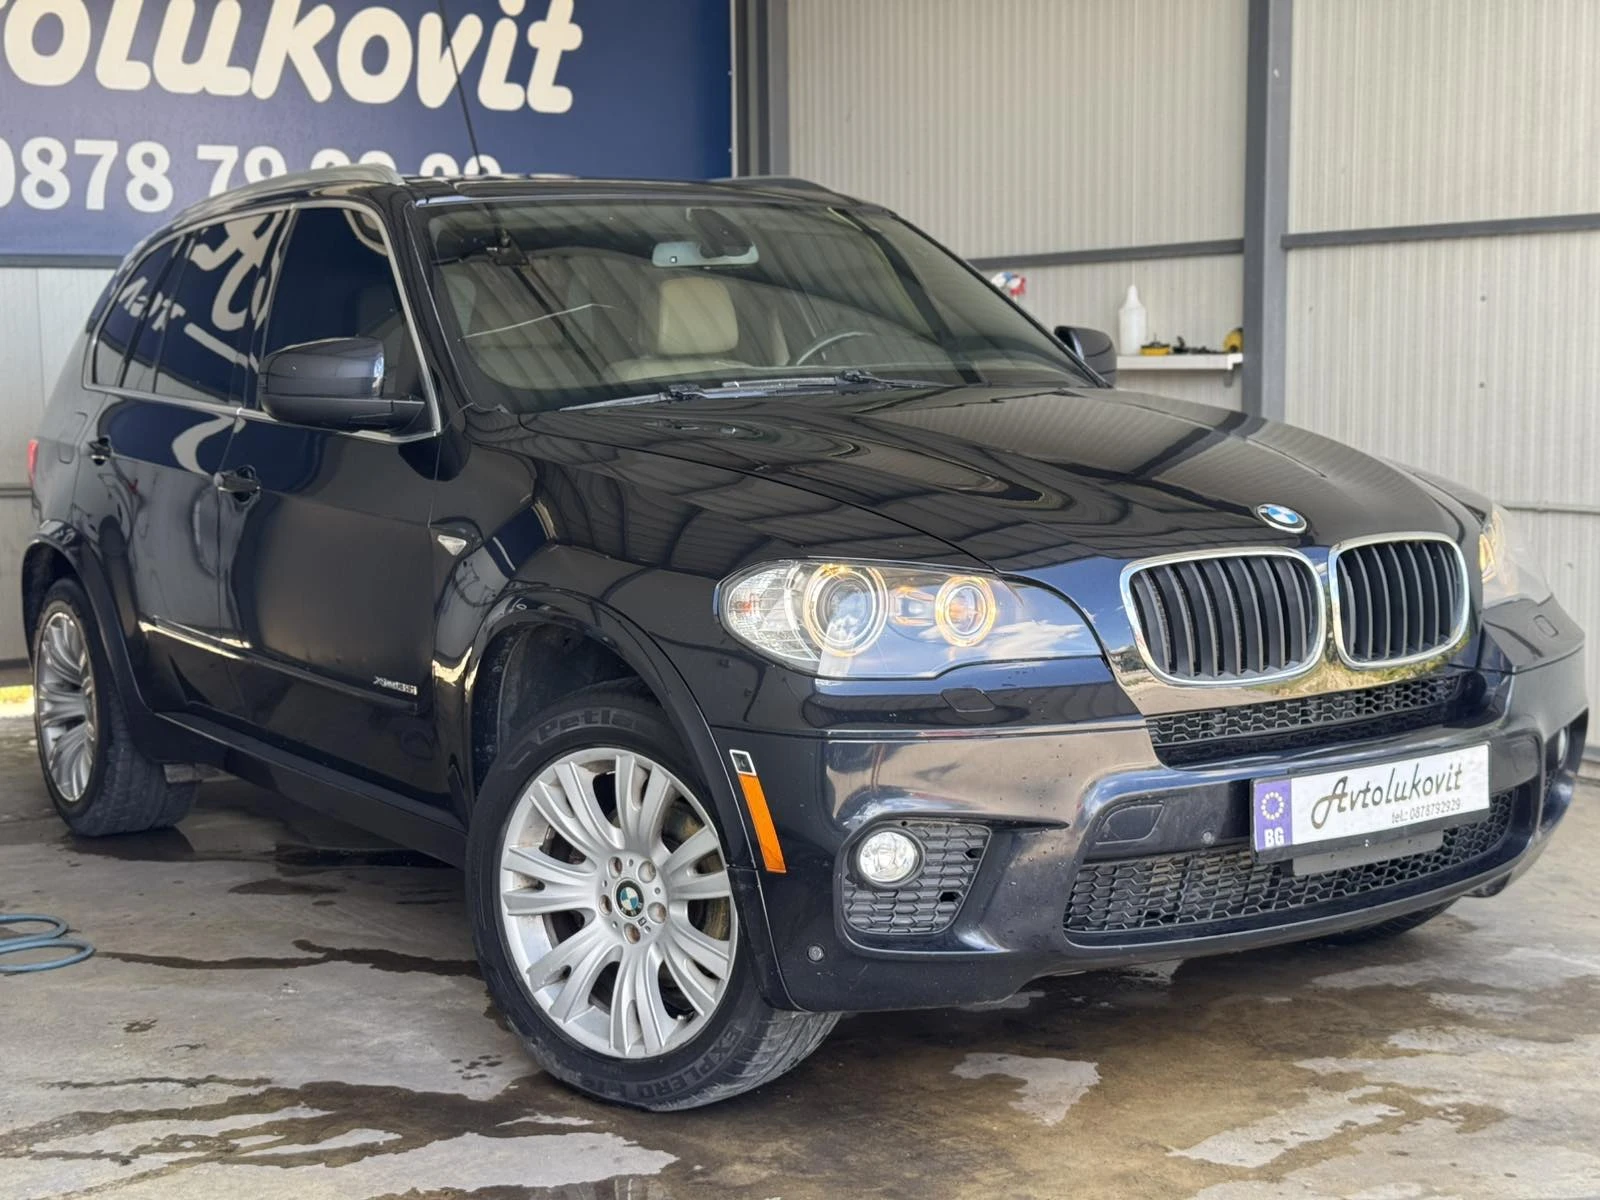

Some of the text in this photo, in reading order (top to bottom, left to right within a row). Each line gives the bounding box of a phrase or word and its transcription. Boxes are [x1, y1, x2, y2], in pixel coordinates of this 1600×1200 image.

[0, 0, 583, 113] olukovit
[1311, 762, 1463, 830] Avtolukovit
[1264, 827, 1285, 848] BG
